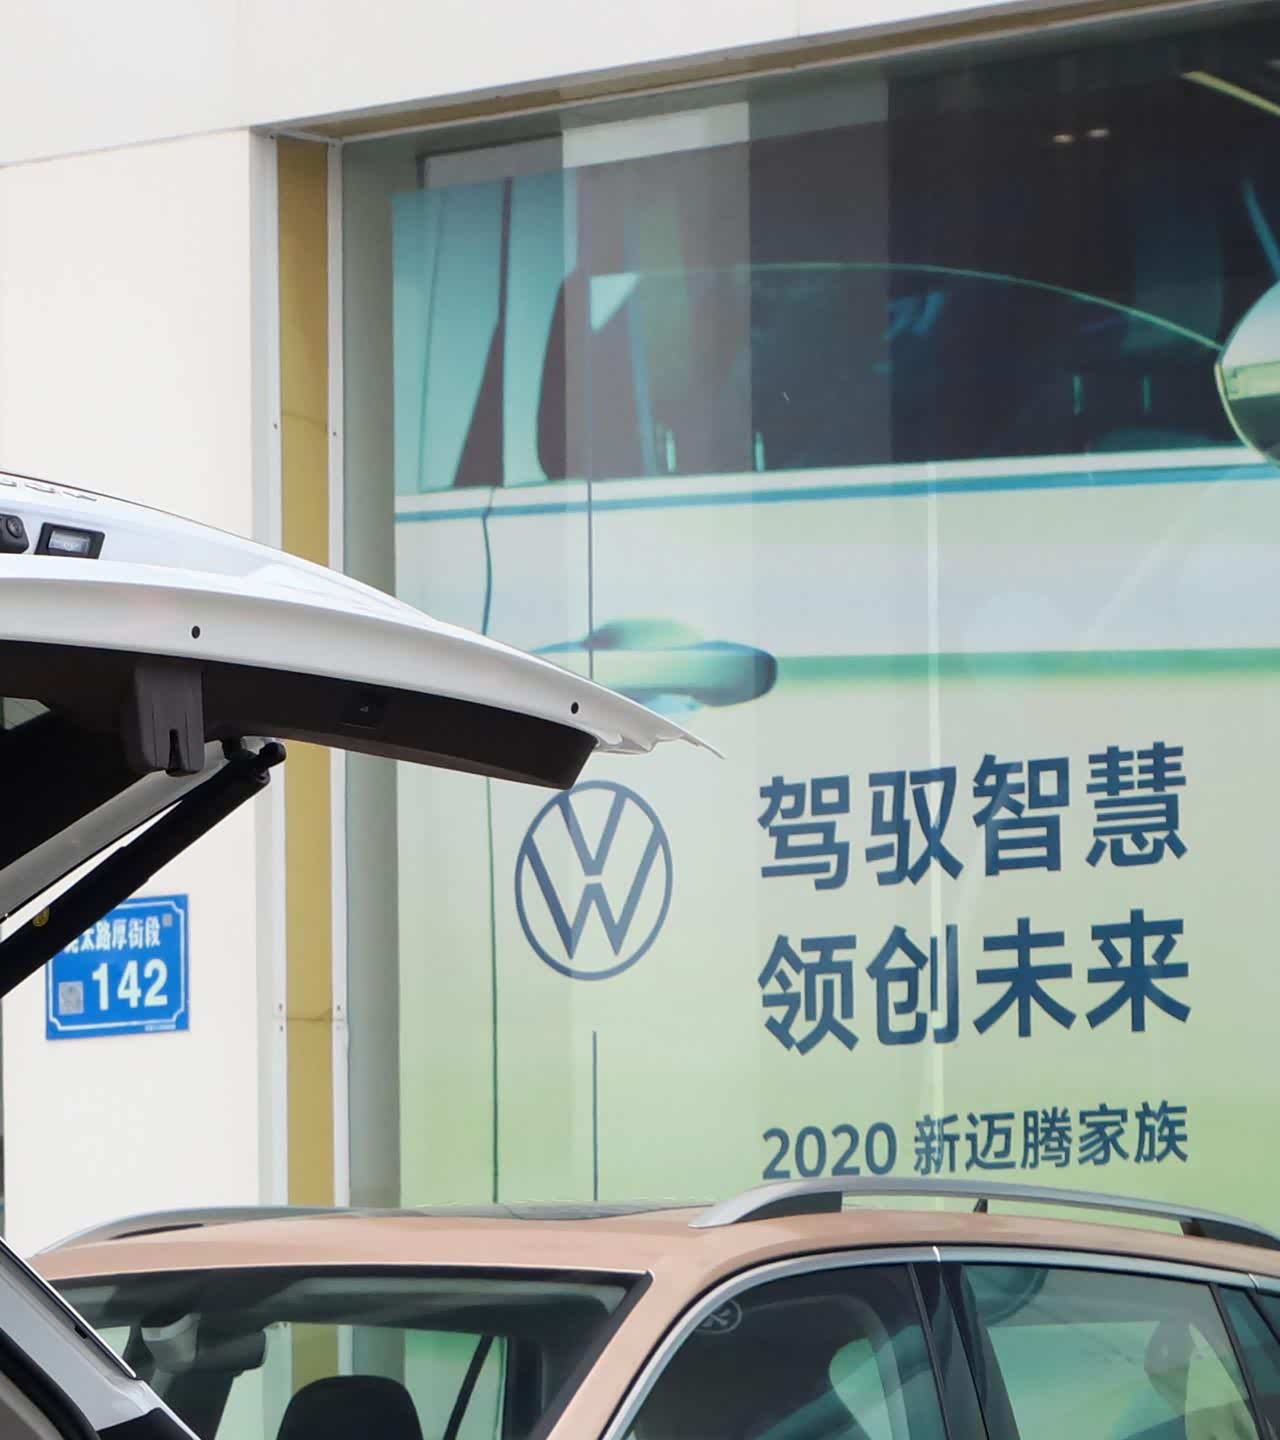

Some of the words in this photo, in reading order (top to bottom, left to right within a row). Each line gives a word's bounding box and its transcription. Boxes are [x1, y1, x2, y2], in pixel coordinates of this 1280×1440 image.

[757, 741, 1188, 890] 驾驭智慧
[92, 958, 168, 1011] 142
[757, 908, 1191, 1056] 领创未来
[762, 1122, 897, 1179] 2020
[913, 1100, 1189, 1176] 新迈腾家族
